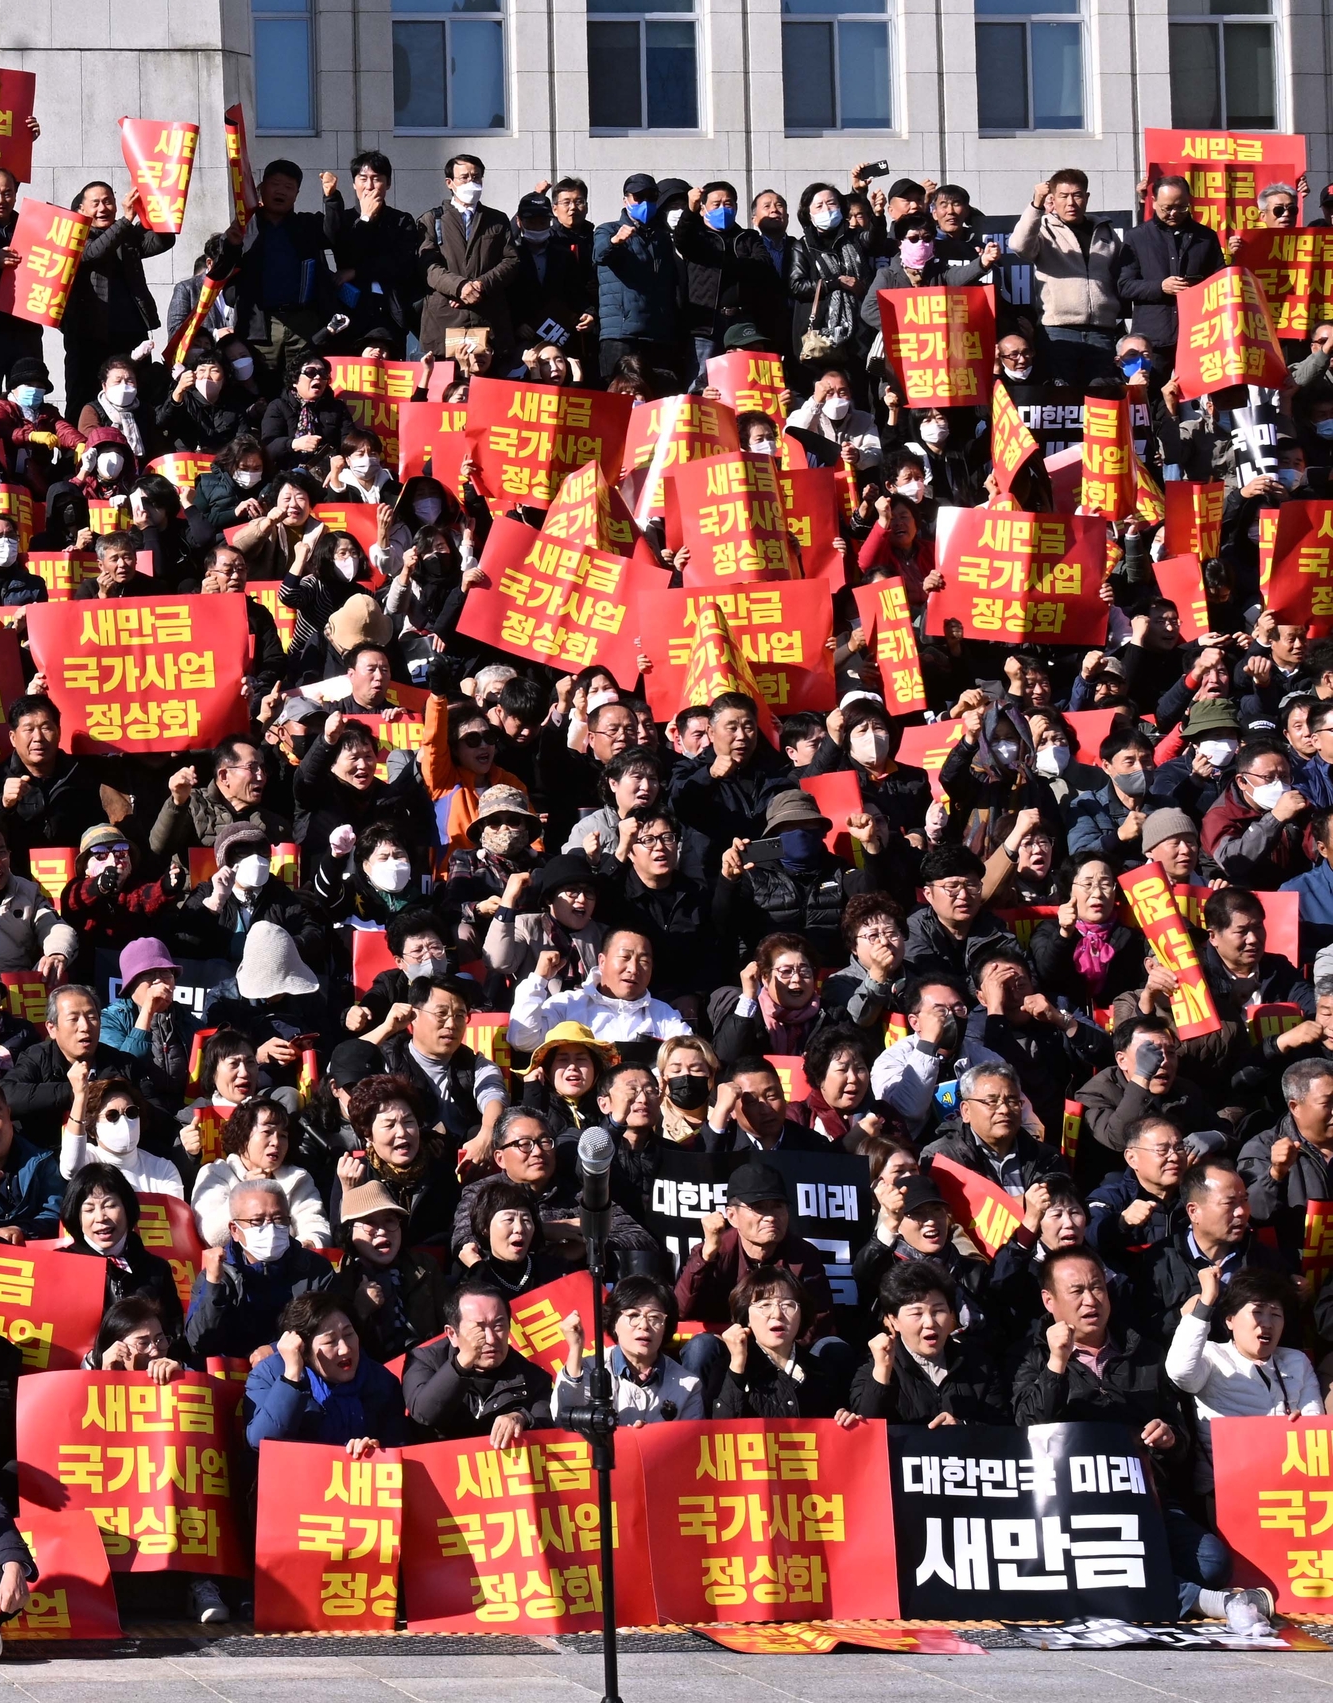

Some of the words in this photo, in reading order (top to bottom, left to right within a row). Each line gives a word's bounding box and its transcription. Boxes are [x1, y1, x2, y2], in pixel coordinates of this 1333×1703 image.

[1181, 137, 1263, 162] 새만금
[1194, 205, 1269, 232] 가사업
[904, 295, 967, 325] 새만금
[1202, 275, 1257, 318] 새만금
[895, 331, 982, 362] 국가사업
[1190, 300, 1278, 354] 국가사업
[332, 365, 414, 398] 새만금
[907, 367, 977, 398] 정상화
[1199, 346, 1264, 383] 정상화
[508, 391, 591, 427] 새만금
[647, 403, 719, 436] 새만금
[1023, 406, 1083, 430] 대한민
[489, 426, 601, 464] 국가사업
[501, 464, 561, 504] 정상
[706, 461, 776, 496] 새만금
[699, 494, 791, 537] 국가사업
[978, 519, 1065, 554] 새만금
[520, 535, 622, 598] 새만금
[712, 539, 788, 576] 정상화
[958, 556, 1081, 594] 국가사업
[499, 563, 626, 639] 국가사업
[971, 597, 1066, 633] 정상화
[80, 605, 192, 646] 새만금
[501, 608, 602, 666] 정상화
[668, 625, 803, 668] 국사업
[64, 651, 215, 694] 국가사업
[86, 699, 201, 741] 정상화
[797, 1183, 858, 1220] 미래
[82, 1384, 214, 1434] 새만금
[58, 1445, 226, 1495] 국가사업
[456, 1441, 592, 1500] 새만금
[697, 1433, 818, 1480] 새만금
[903, 1456, 1058, 1498] 대한민국
[1070, 1455, 1147, 1495] 미래
[85, 1505, 220, 1556] 정상화
[298, 1514, 399, 1563] 국가
[437, 1501, 619, 1563] 국가사업
[679, 1494, 845, 1543] 국가사업
[916, 1514, 1147, 1590] 새만금
[471, 1565, 603, 1622] 정상화
[702, 1555, 826, 1605] 정상화
